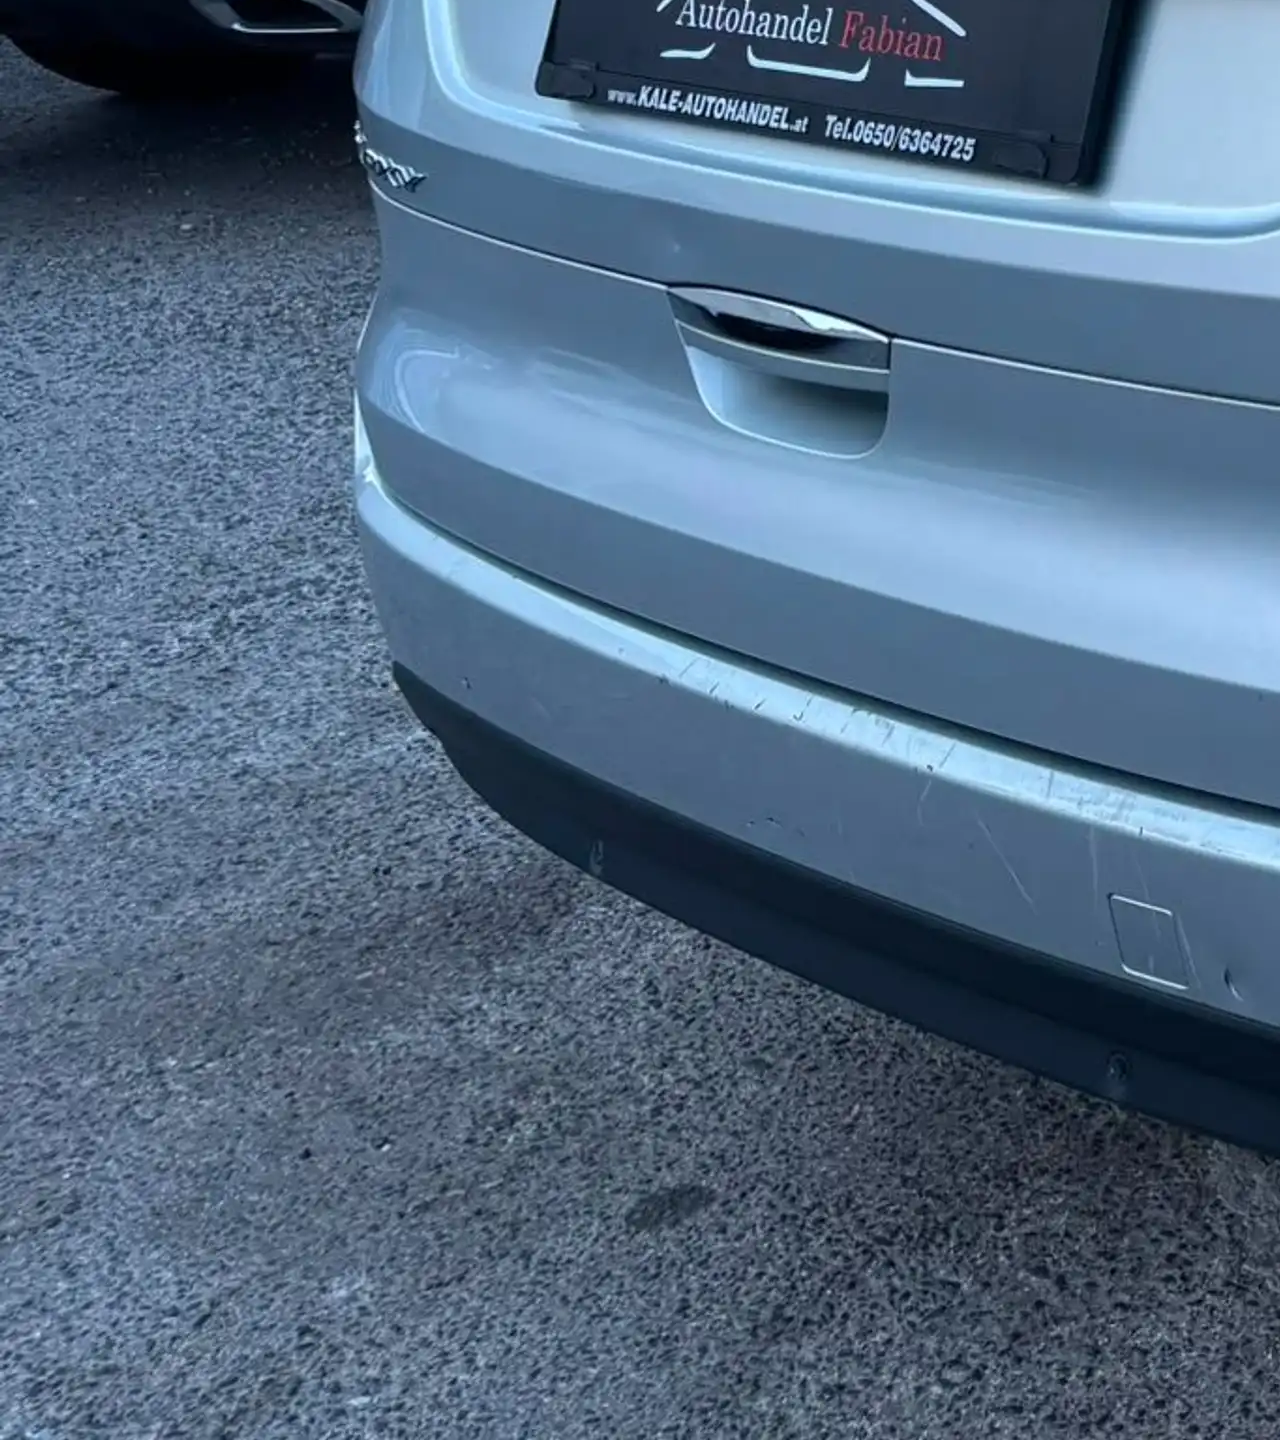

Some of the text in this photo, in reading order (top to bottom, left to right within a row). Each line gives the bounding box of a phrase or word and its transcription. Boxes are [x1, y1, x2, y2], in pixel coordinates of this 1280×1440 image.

[838, 9, 945, 62] Fabian
[606, 83, 977, 162] www.KALE-AUTOHANDEL.at Tel.0650/6364725
